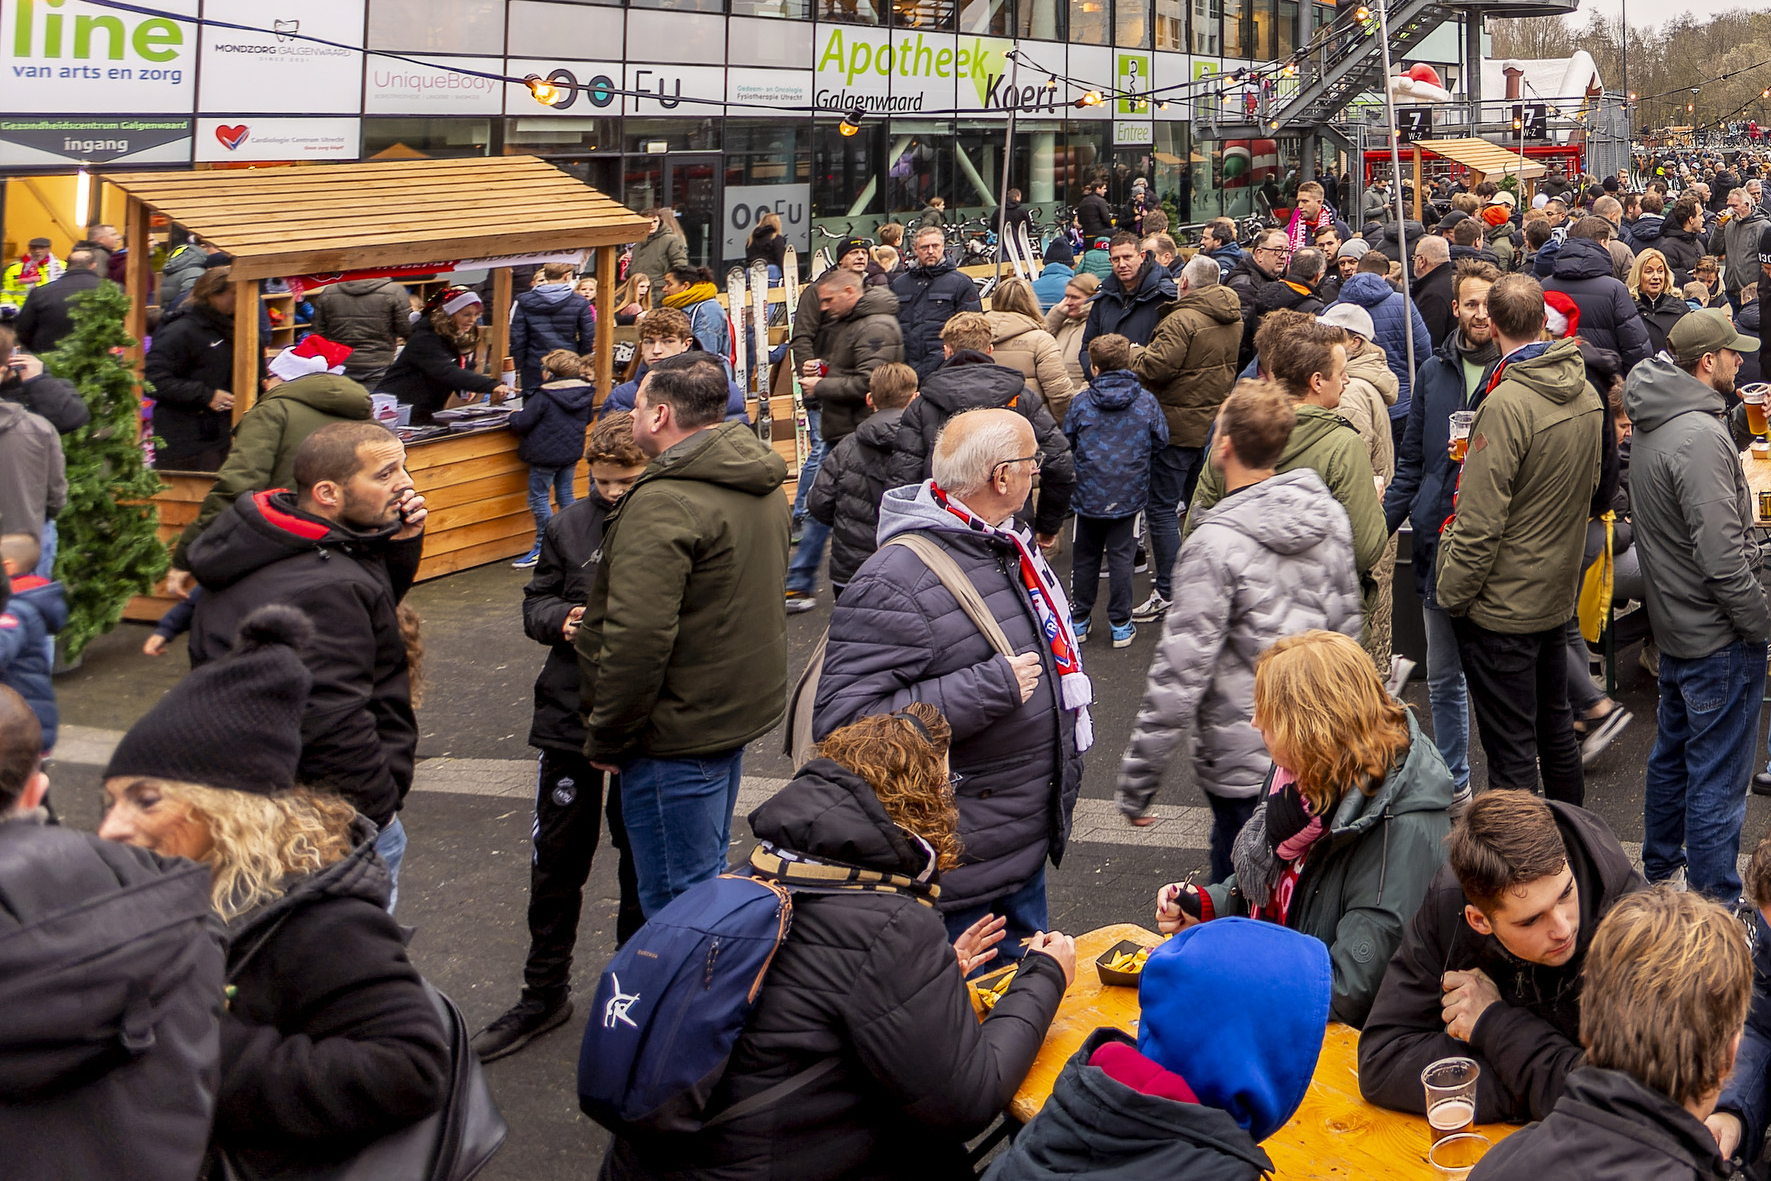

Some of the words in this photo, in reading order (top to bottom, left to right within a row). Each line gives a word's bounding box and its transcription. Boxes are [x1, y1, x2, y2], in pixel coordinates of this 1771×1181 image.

[215, 44, 277, 55] MONDZORG
[278, 46, 351, 58] GALGENWAARD
[818, 28, 989, 86] Apotheek
[13, 65, 52, 79] van
[59, 64, 101, 80] arts
[107, 67, 132, 80] en
[139, 68, 182, 85] zorg
[374, 70, 496, 94] UniqueBody
[736, 93, 779, 101] Fysiotherapie
[816, 88, 924, 112] Galgenwaard
[985, 73, 1059, 114] Koert
[1, 121, 119, 131] Gezondheidscentrum
[120, 120, 188, 132] Galgenwaard
[1409, 112, 1422, 131] 7
[1524, 108, 1536, 127] 7
[1117, 122, 1149, 141] Entree
[1407, 132, 1423, 141] W-Z
[64, 137, 129, 153] ingang
